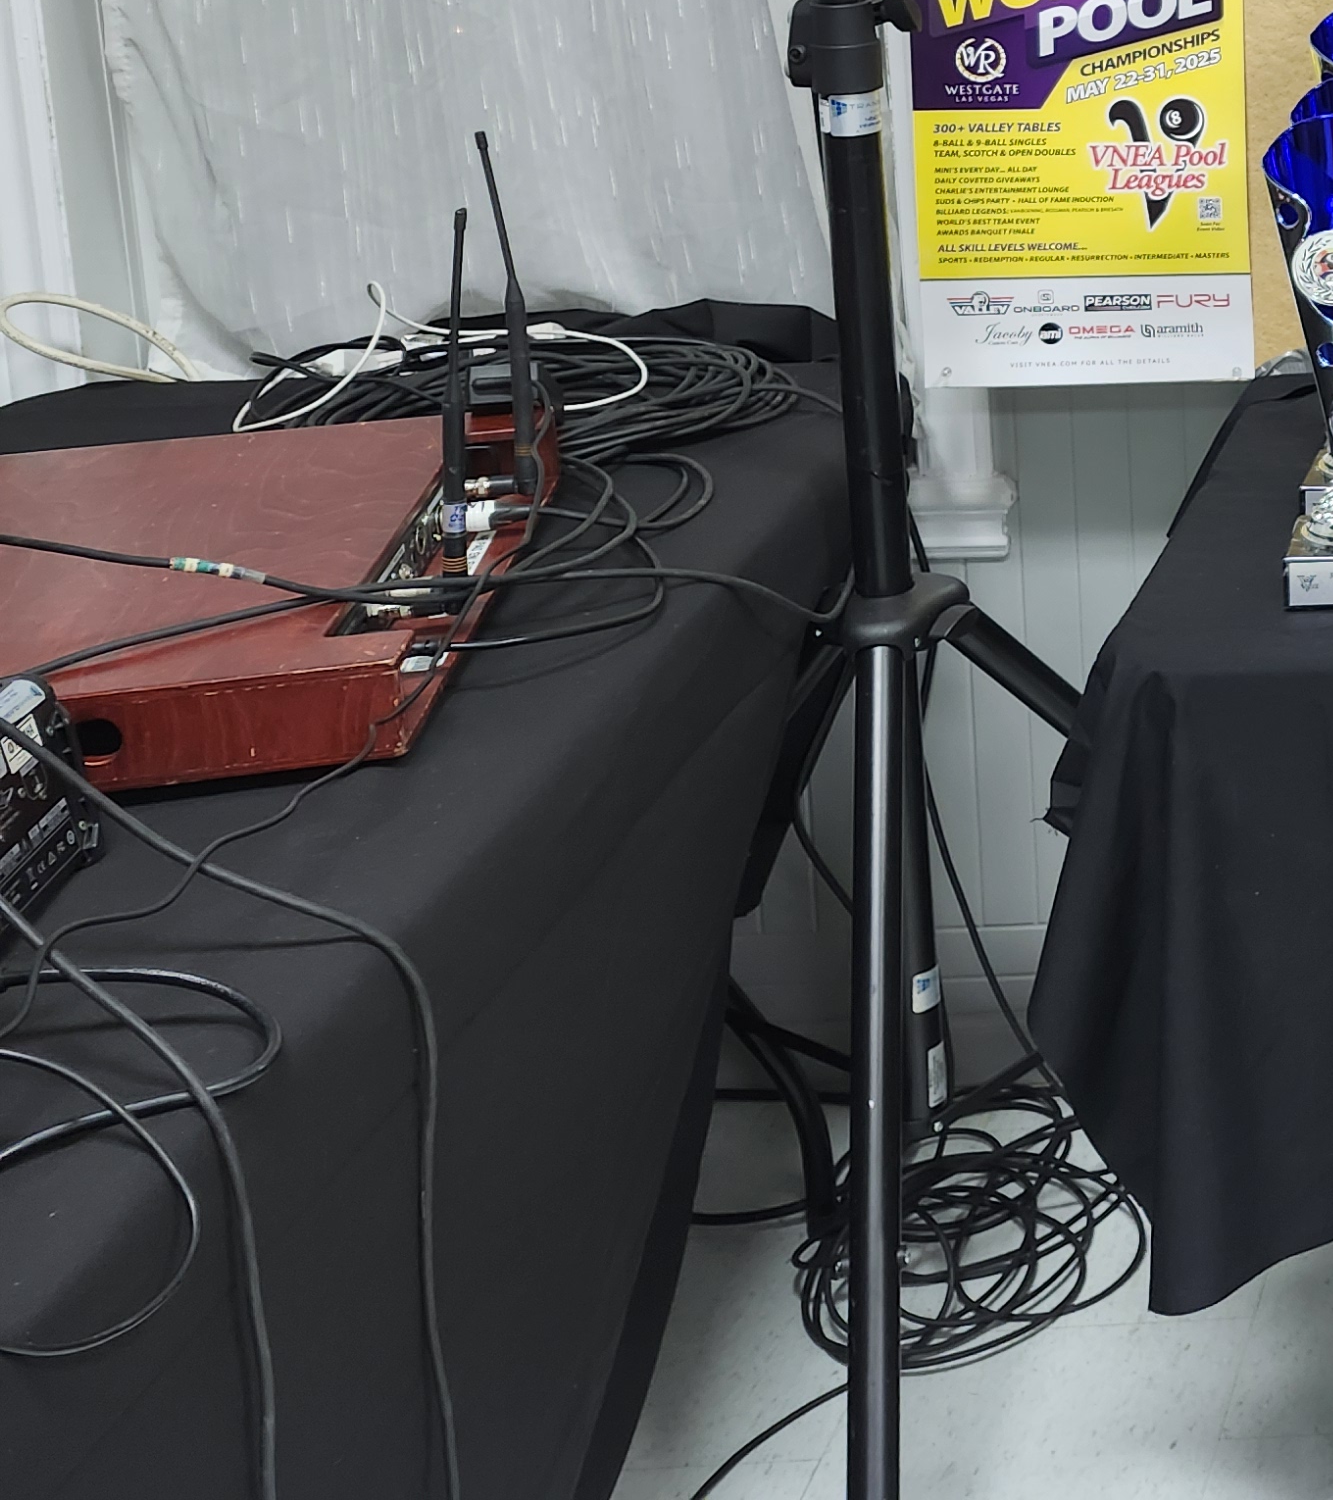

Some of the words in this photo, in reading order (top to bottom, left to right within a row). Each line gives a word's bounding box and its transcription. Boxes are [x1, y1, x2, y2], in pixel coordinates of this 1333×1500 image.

[1080, 29, 1220, 77] CHAMPIONSHIPS
[1090, 145, 1164, 168] VNEA
[1173, 143, 1227, 167] Pool
[1109, 170, 1206, 200] Leagues
